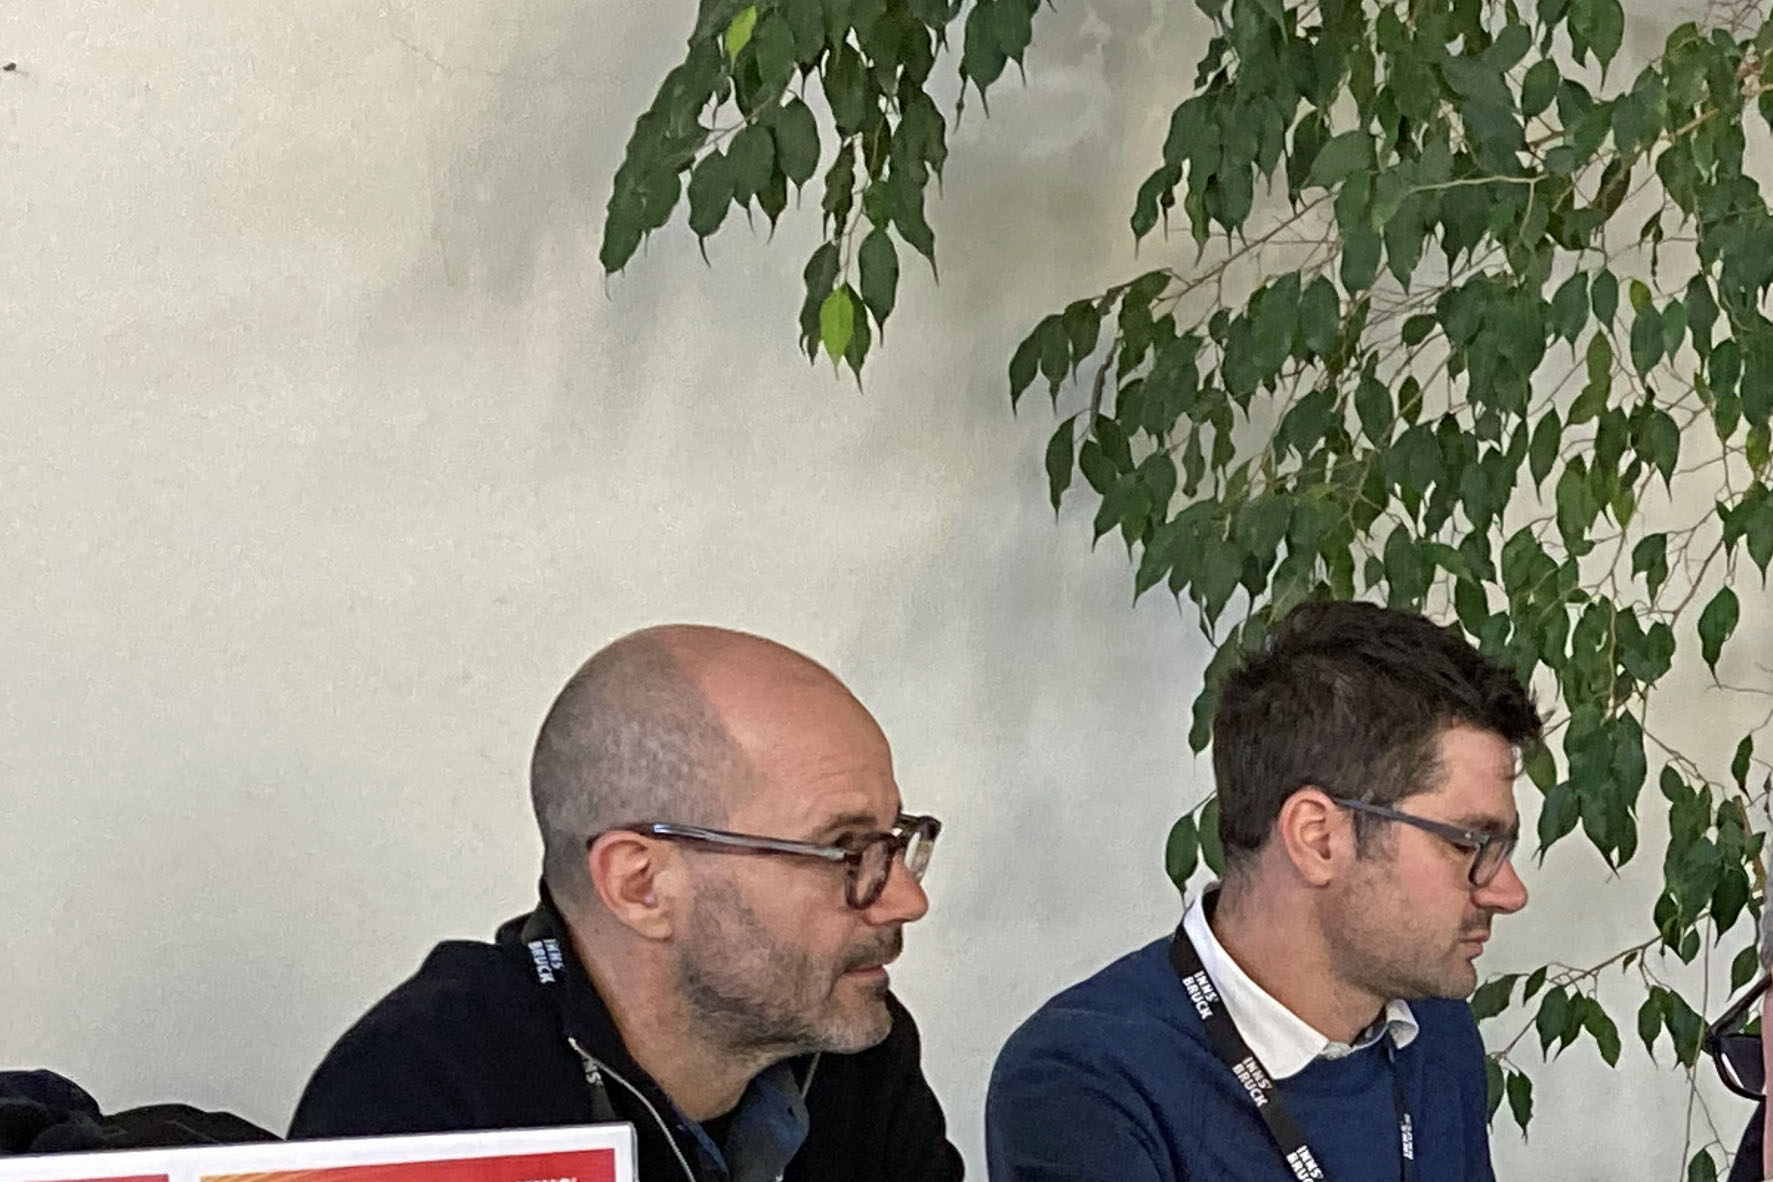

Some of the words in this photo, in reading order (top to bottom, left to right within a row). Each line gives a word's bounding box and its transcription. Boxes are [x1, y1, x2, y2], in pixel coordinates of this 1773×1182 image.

[1182, 976, 1213, 1020] BRUCK
[1194, 970, 1219, 1004] INNS'
[1232, 1063, 1268, 1107] BRUCK
[1243, 1056, 1273, 1090] INNS'
[1297, 1145, 1324, 1180] INNS'
